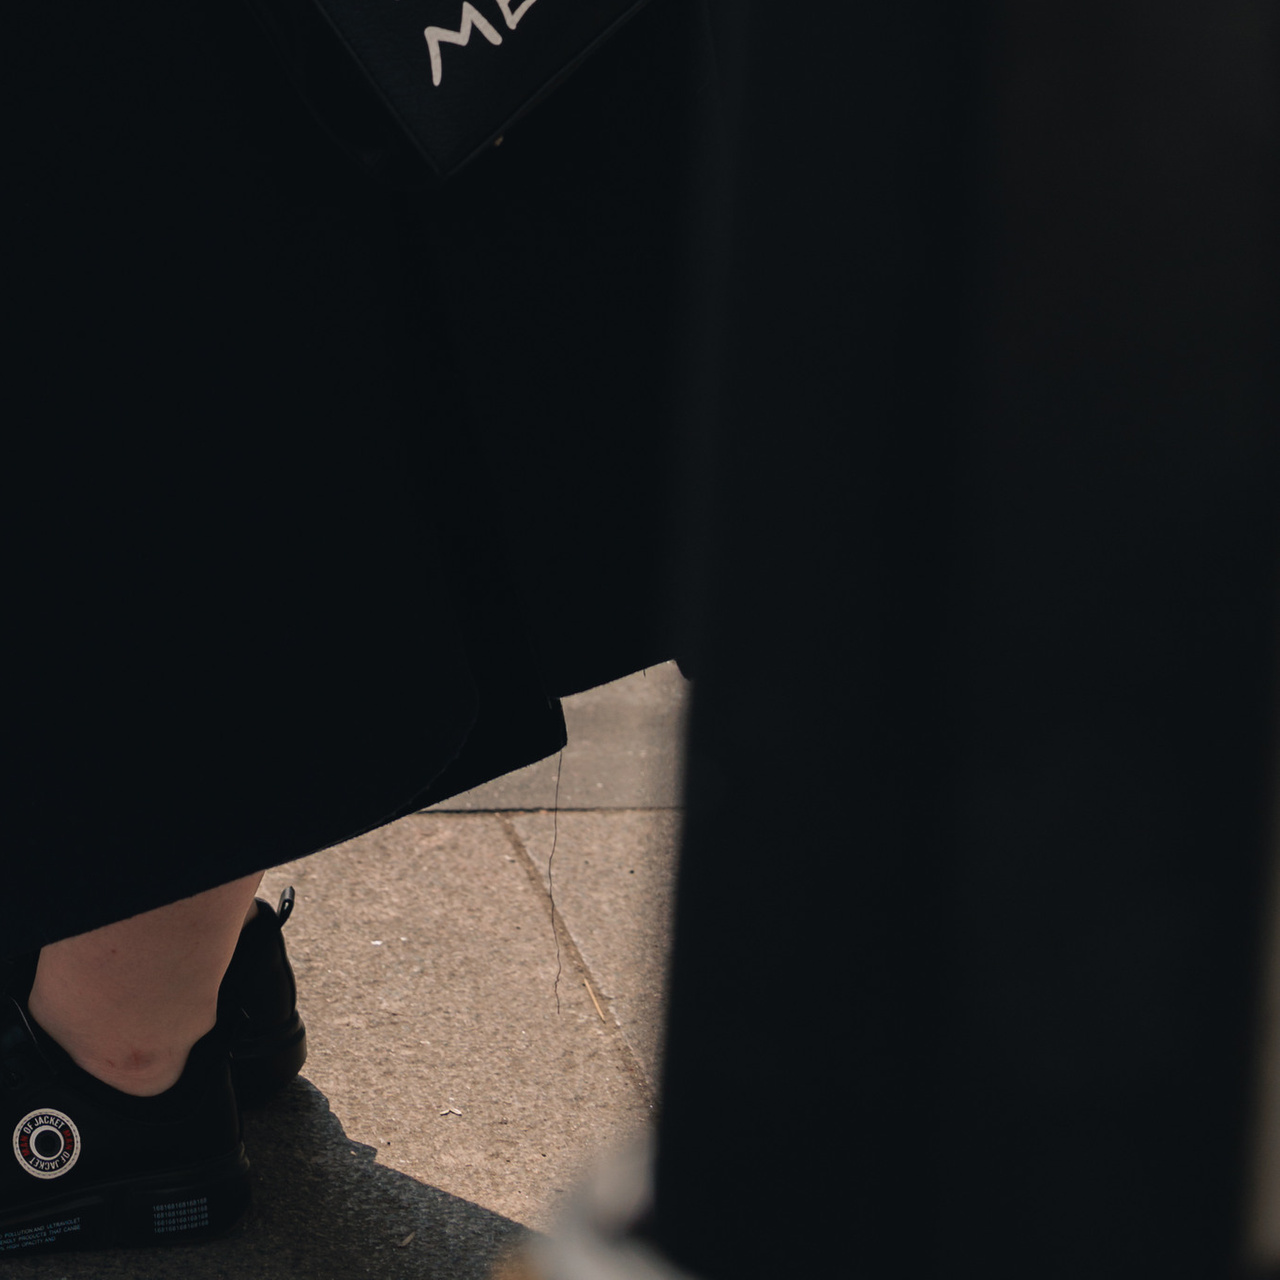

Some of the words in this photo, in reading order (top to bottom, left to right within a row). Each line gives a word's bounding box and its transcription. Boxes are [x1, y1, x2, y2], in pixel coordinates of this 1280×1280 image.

[23, 1122, 34, 1134] OF
[34, 1115, 65, 1130] JACKET
[29, 1156, 60, 1171] JACKET
[60, 1150, 71, 1164] OF
